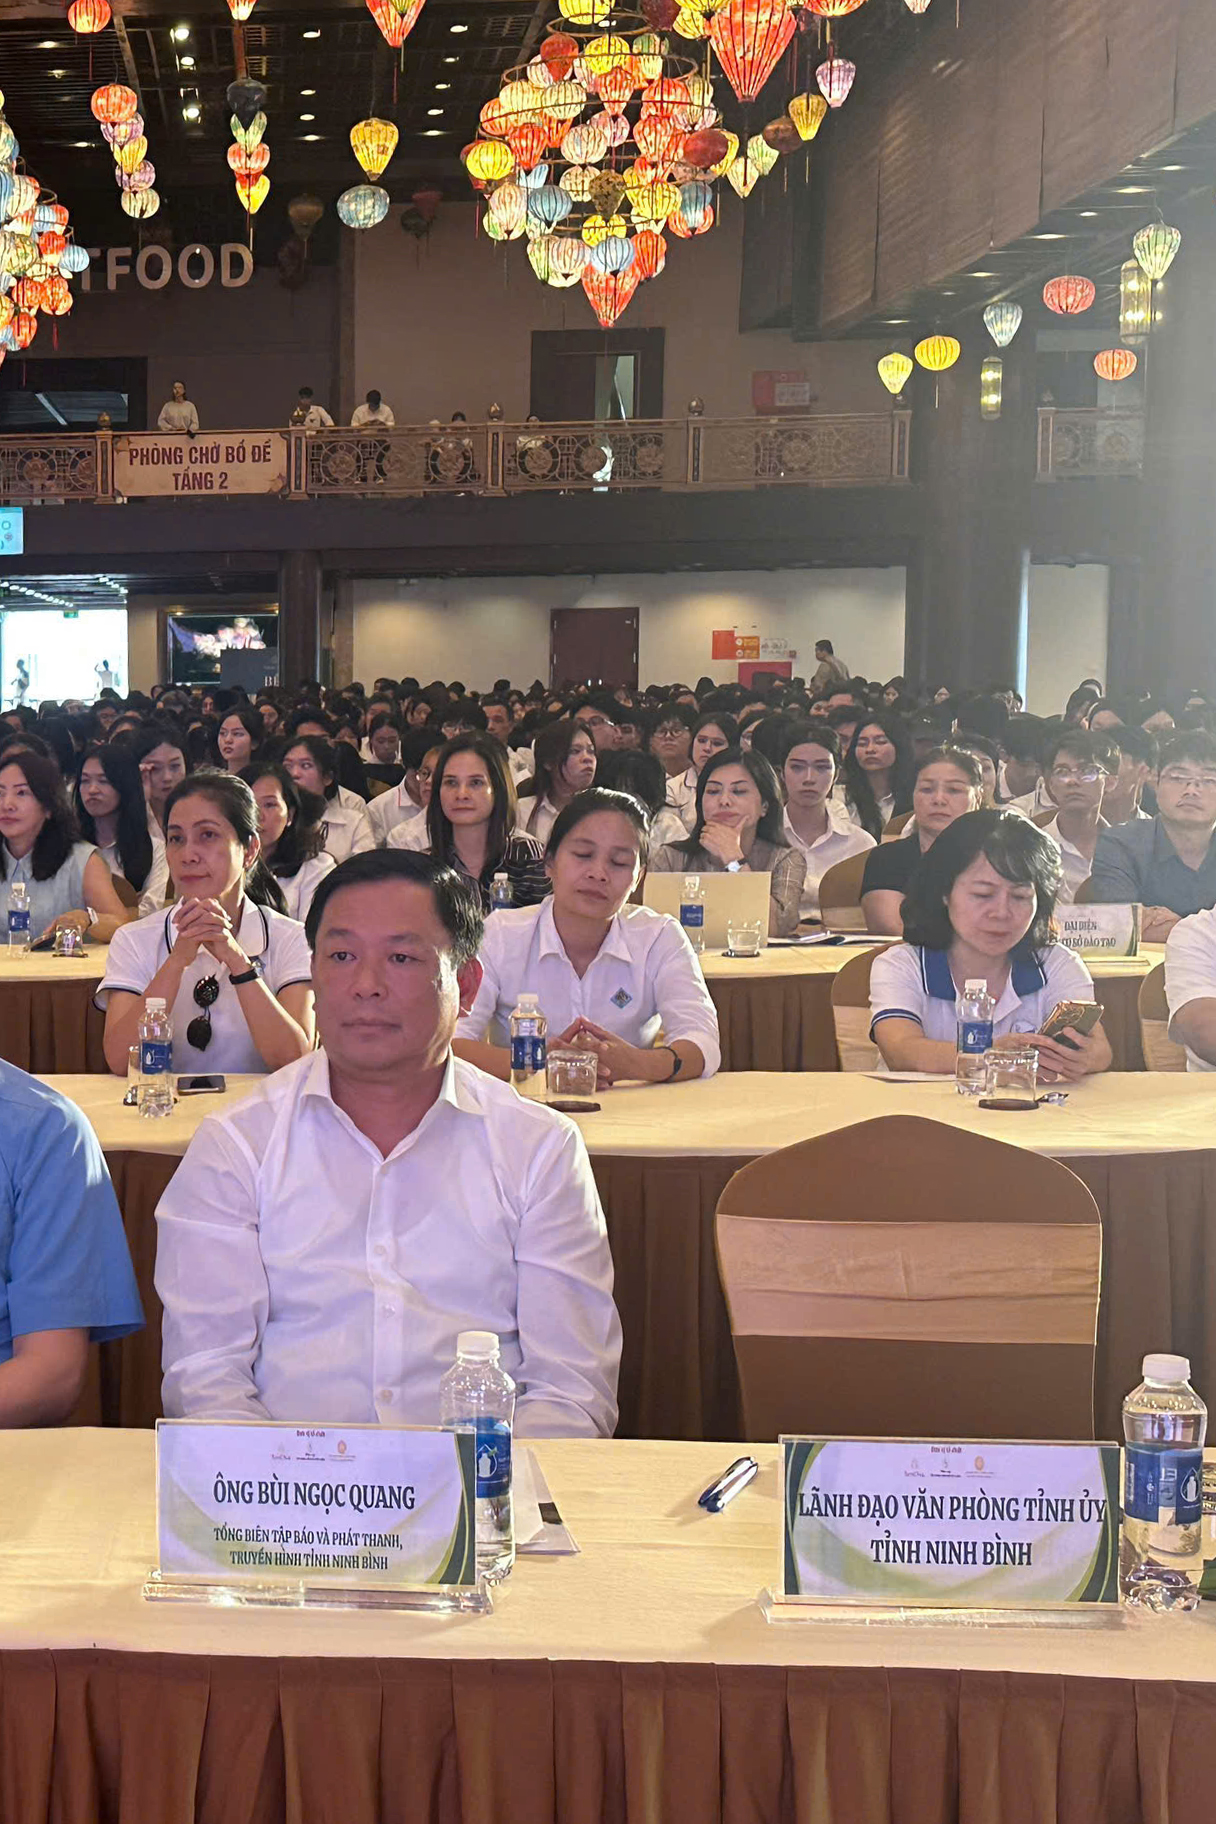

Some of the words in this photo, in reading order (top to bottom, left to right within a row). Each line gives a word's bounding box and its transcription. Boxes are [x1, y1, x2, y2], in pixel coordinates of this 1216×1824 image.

[129, 443, 184, 466] PHÒNG
[189, 441, 221, 465] CHỜ
[172, 466, 214, 491] TẦNG
[218, 471, 228, 490] 2
[213, 1471, 253, 1504] ÔNG
[257, 1473, 289, 1505] BÙI
[294, 1480, 345, 1515] NGỌC
[349, 1485, 415, 1513] QUANG
[798, 1486, 853, 1518] LÃNH
[857, 1494, 899, 1527] ĐẠO
[902, 1487, 944, 1520] VĂN
[948, 1487, 1020, 1522] PHÒNG
[1023, 1488, 1074, 1522] TỈNH
[1079, 1489, 1108, 1523] ỦY
[213, 1521, 243, 1542] TỔNG
[244, 1525, 270, 1543] BIÊN
[271, 1526, 292, 1546] TẬP
[293, 1526, 314, 1545] BÁO
[316, 1527, 332, 1546] VÀ
[332, 1527, 360, 1547] PHÁT
[361, 1533, 403, 1551] THANH,
[871, 1529, 921, 1564] TỈNH
[925, 1540, 978, 1565] NINH
[982, 1532, 1033, 1566] BÌNH
[274, 1545, 302, 1567] HÌNH
[302, 1548, 330, 1568] TỈNH
[332, 1555, 359, 1569] NINH
[361, 1550, 388, 1570] BÌNH
